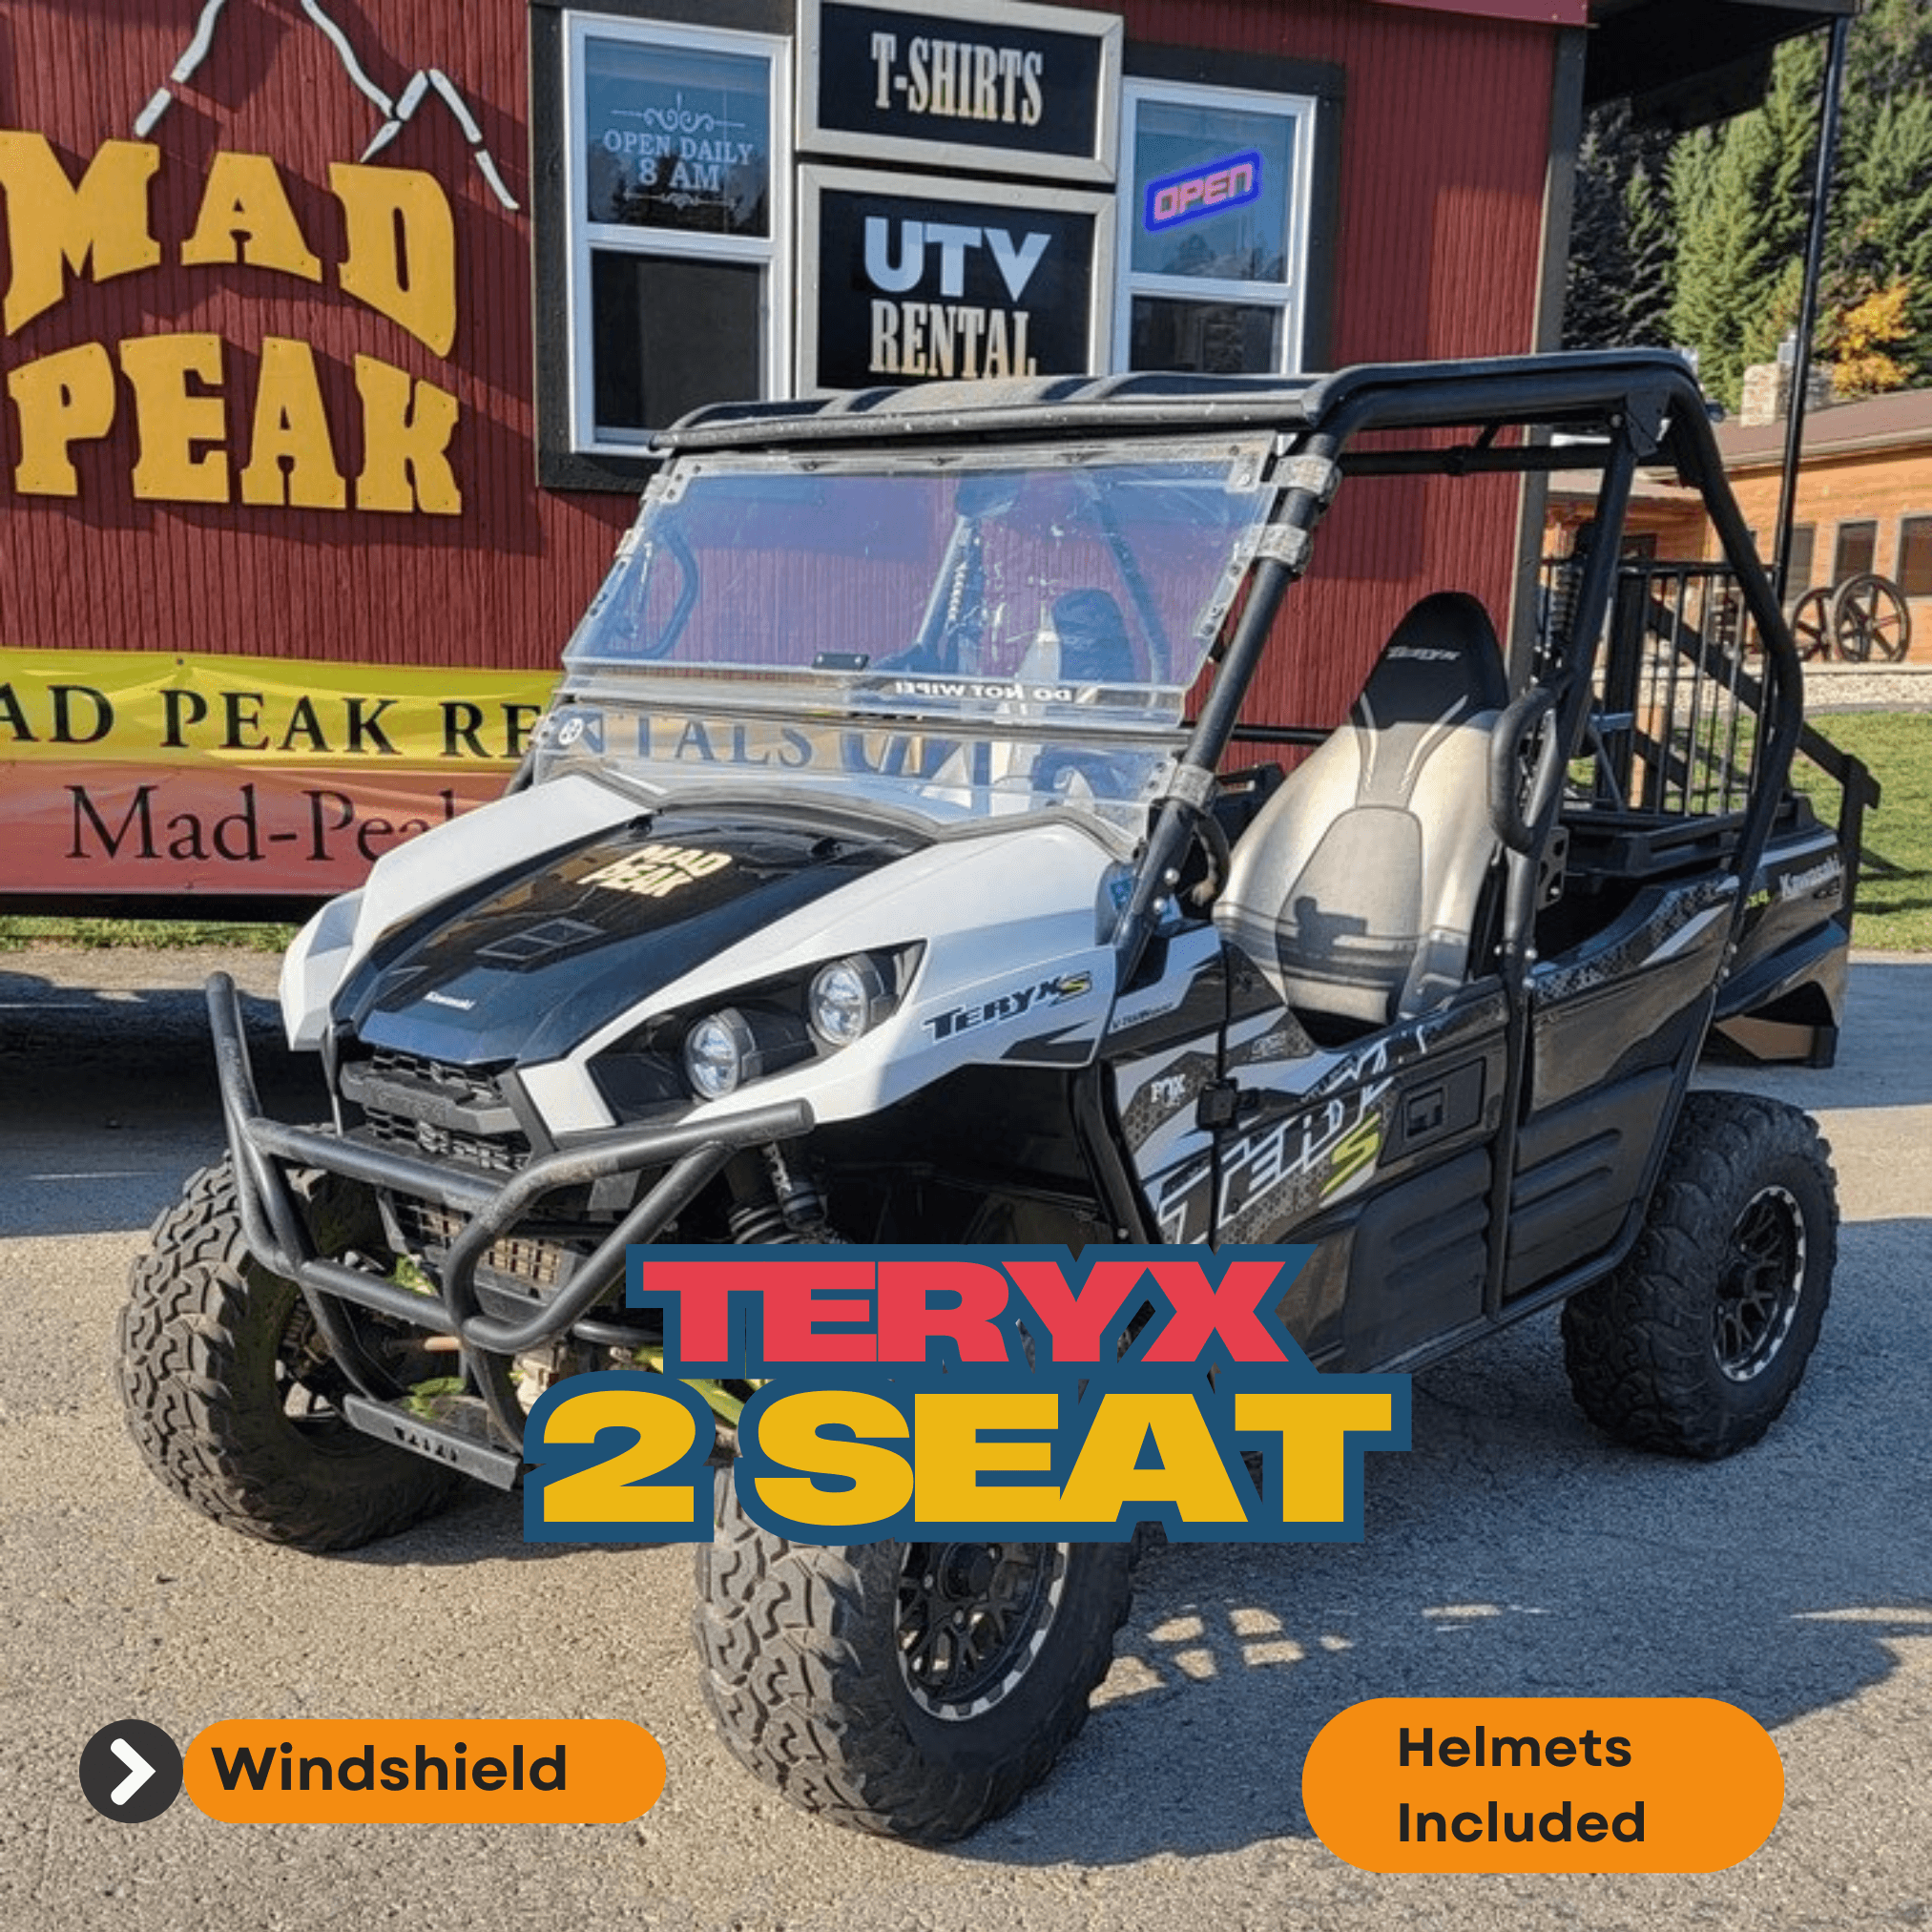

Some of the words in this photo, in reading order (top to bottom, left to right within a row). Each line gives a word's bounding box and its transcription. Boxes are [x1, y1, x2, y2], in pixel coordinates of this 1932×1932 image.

[871, 31, 1044, 127] T-SHIRTS
[603, 129, 671, 157] OPEN
[680, 136, 754, 165] DAILY
[638, 157, 657, 186] 8
[669, 160, 720, 191] AM
[1153, 162, 1254, 221] OPEN
[0, 130, 458, 358] MAD
[864, 216, 1051, 302] UTV
[869, 299, 1037, 379] RENTAL
[7, 333, 462, 515] PEAK
[159, 688, 402, 756] PEAK
[65, 782, 455, 861] Mad-Pe
